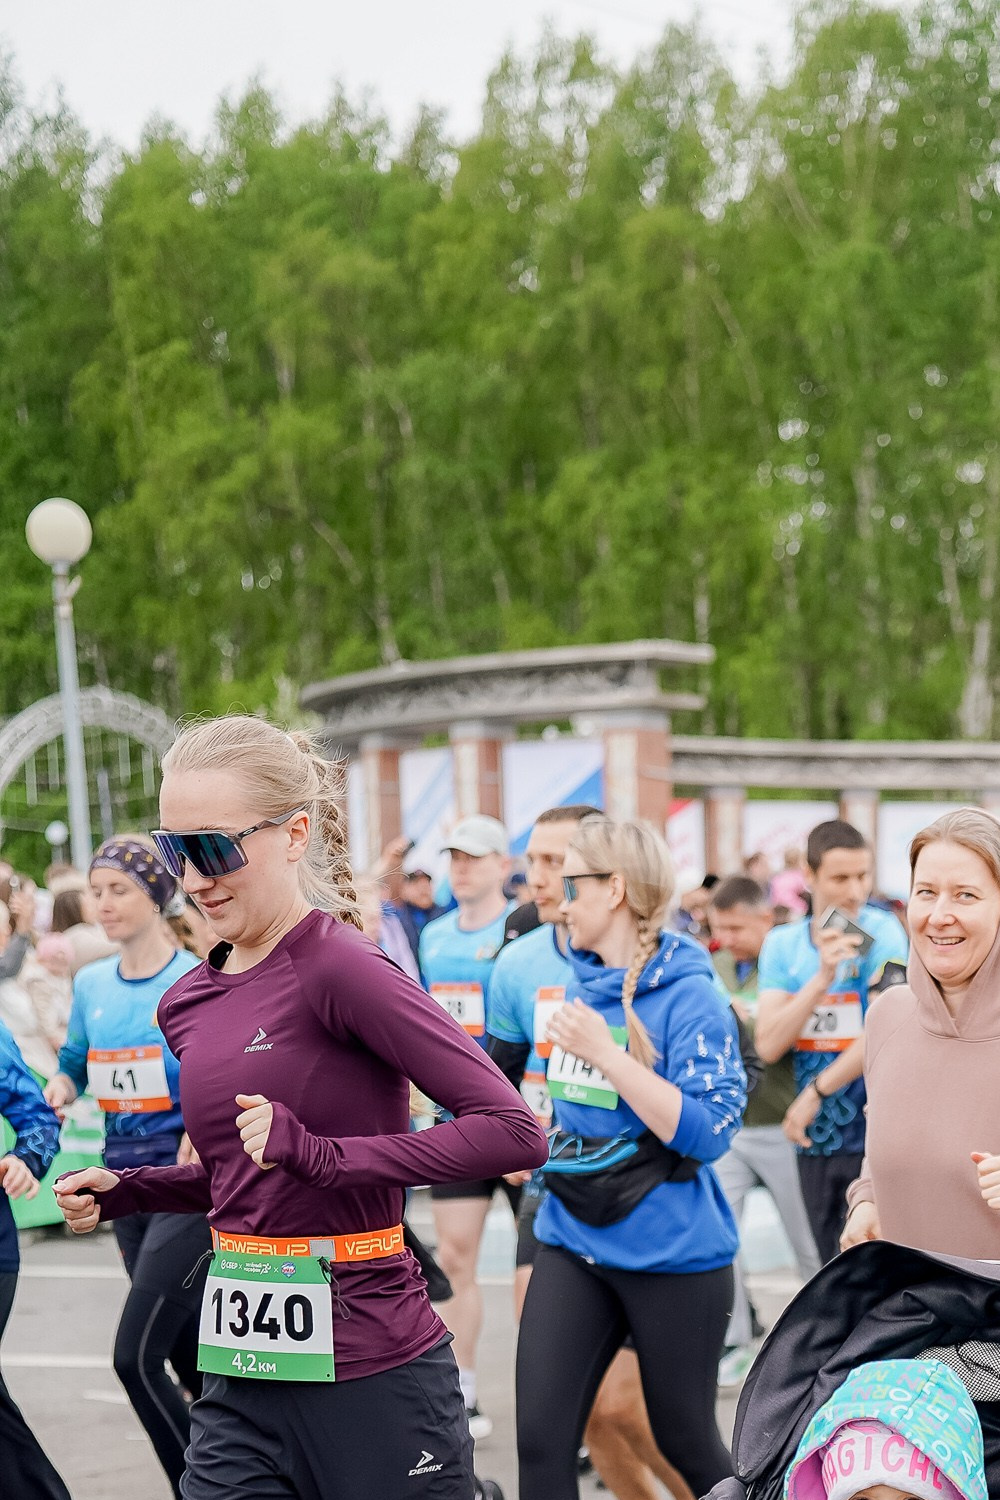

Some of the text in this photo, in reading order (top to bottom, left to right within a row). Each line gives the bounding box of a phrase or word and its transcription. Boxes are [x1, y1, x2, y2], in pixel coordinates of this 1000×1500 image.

[244, 1043, 274, 1053] DEMIX
[112, 1068, 137, 1093] 41
[219, 1236, 309, 1257] POWERUP
[211, 1287, 314, 1342] 1340
[408, 1463, 443, 1476] DEMIX
